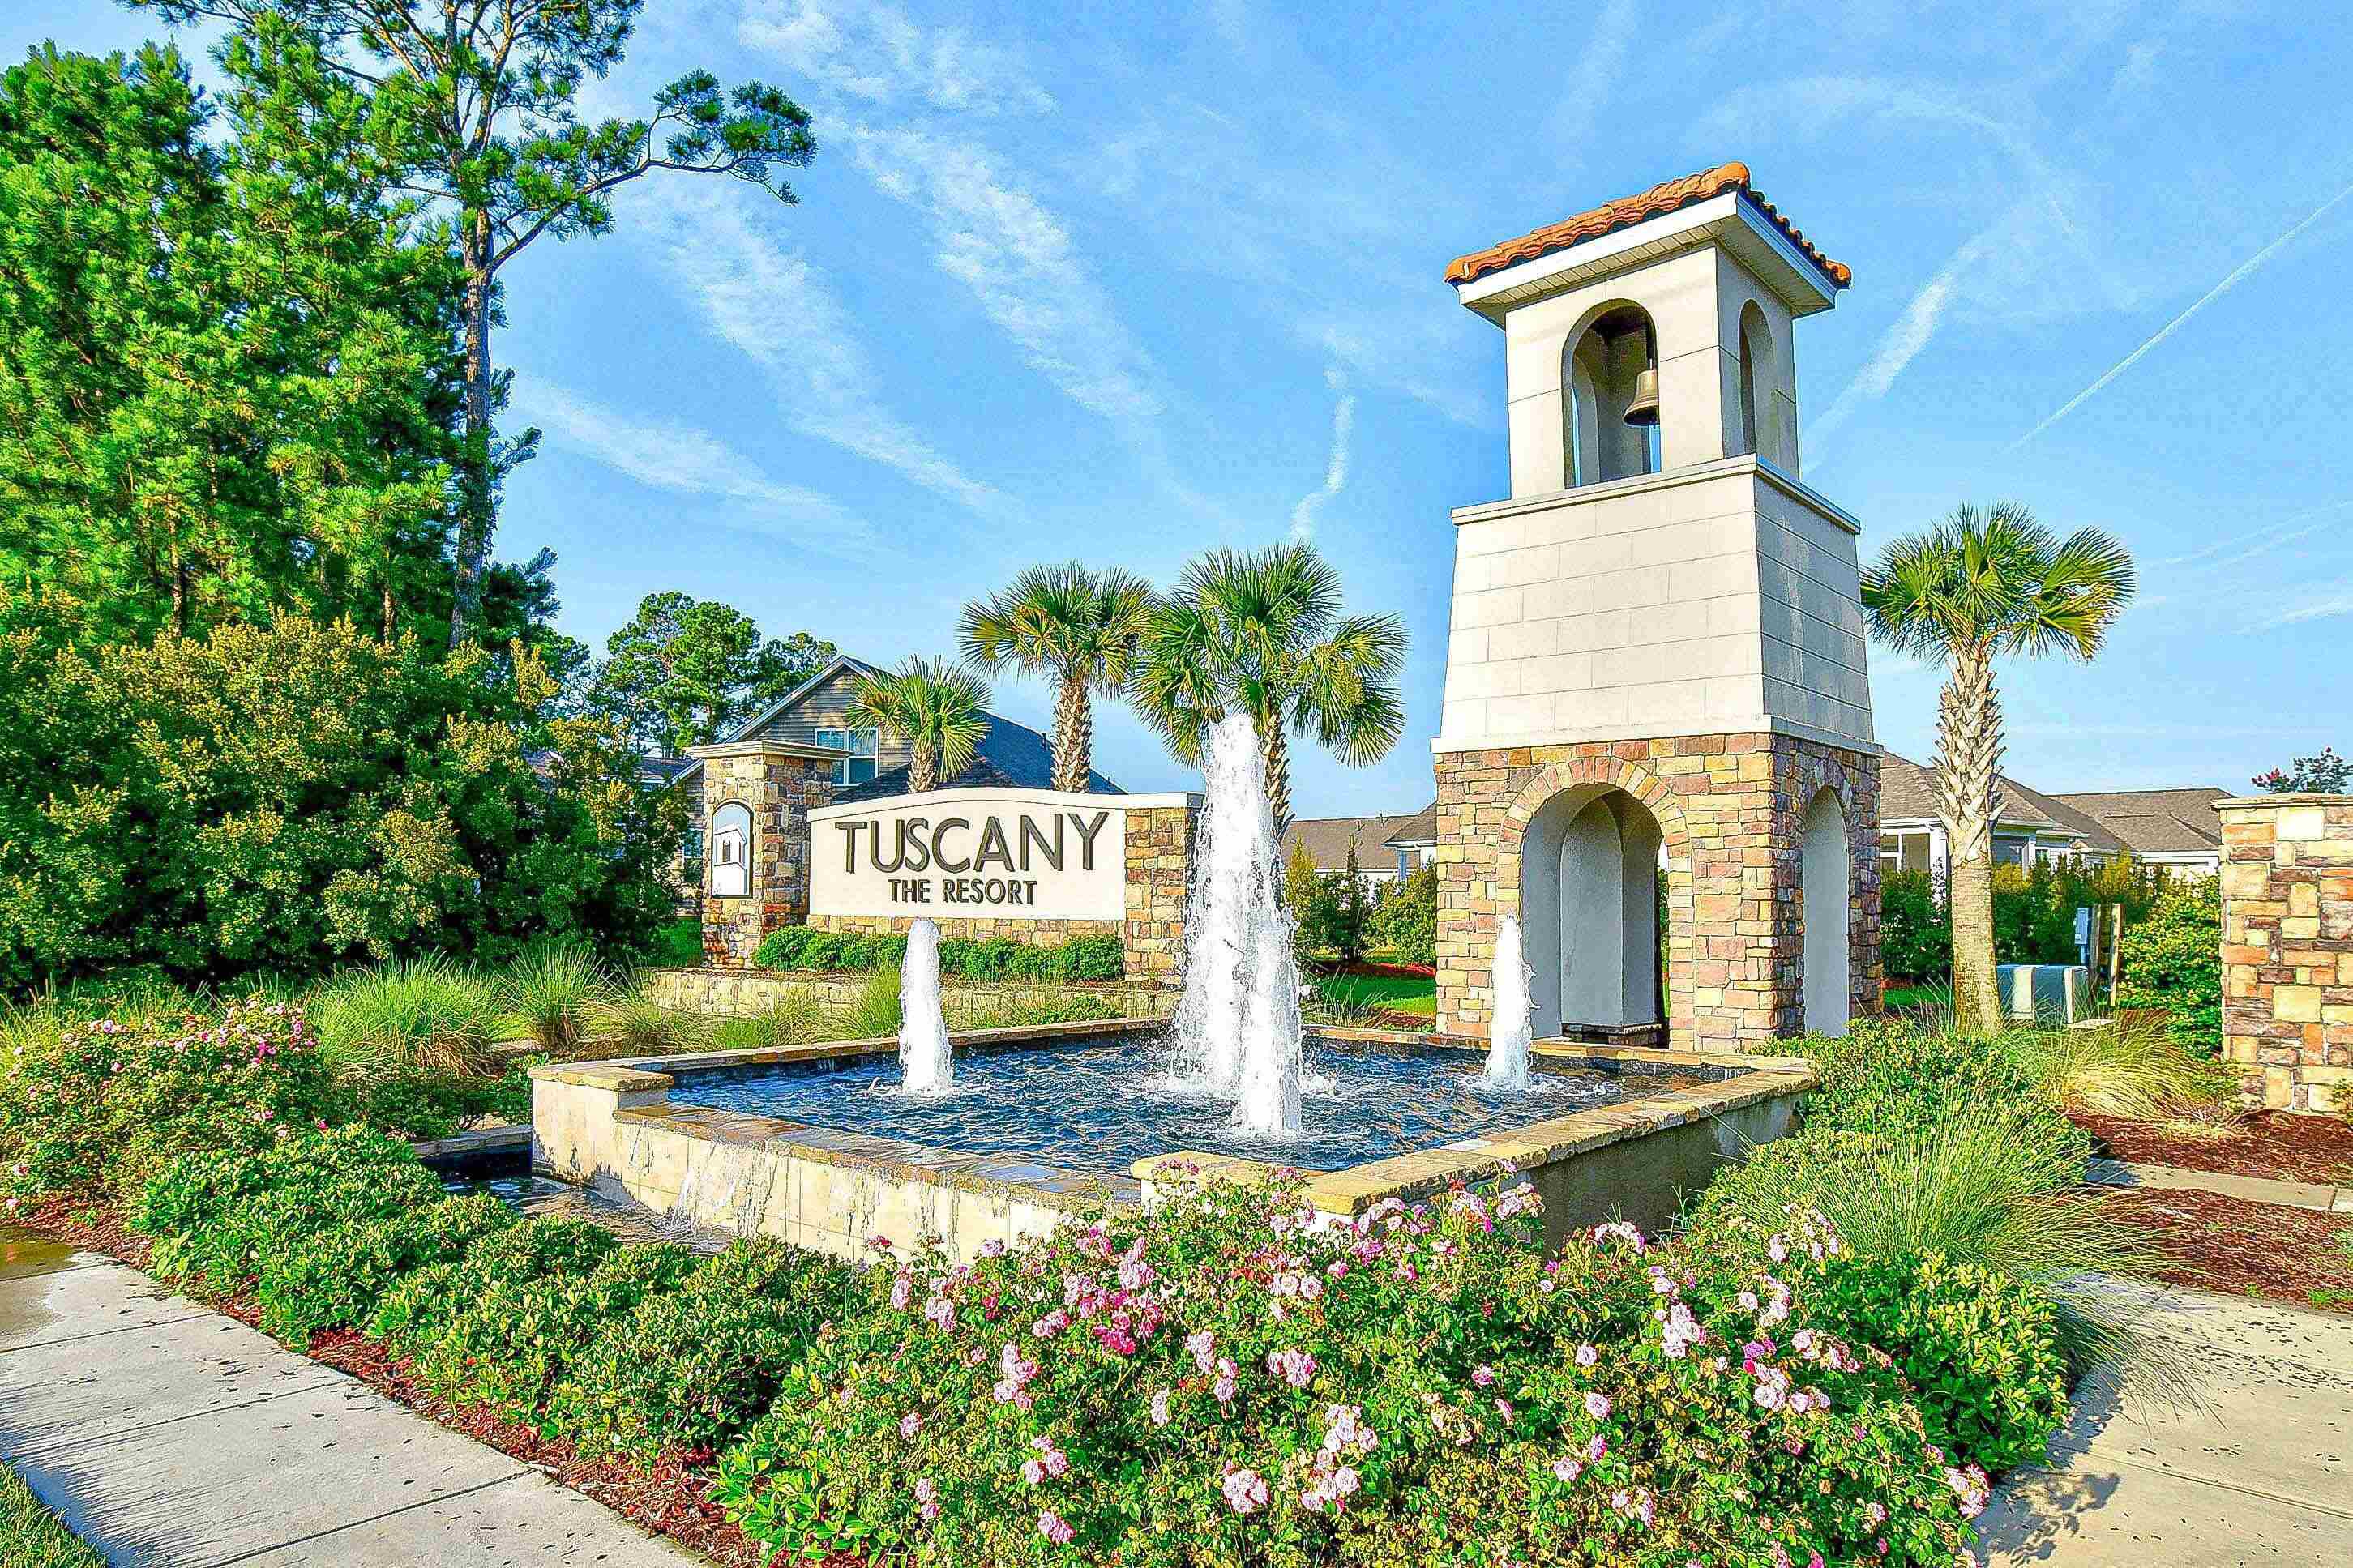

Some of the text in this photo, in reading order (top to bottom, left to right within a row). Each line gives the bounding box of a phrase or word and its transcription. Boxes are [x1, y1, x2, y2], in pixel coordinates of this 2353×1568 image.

[834, 811, 1110, 874] TUSCANY
[888, 878, 1038, 906] THE RESORT
